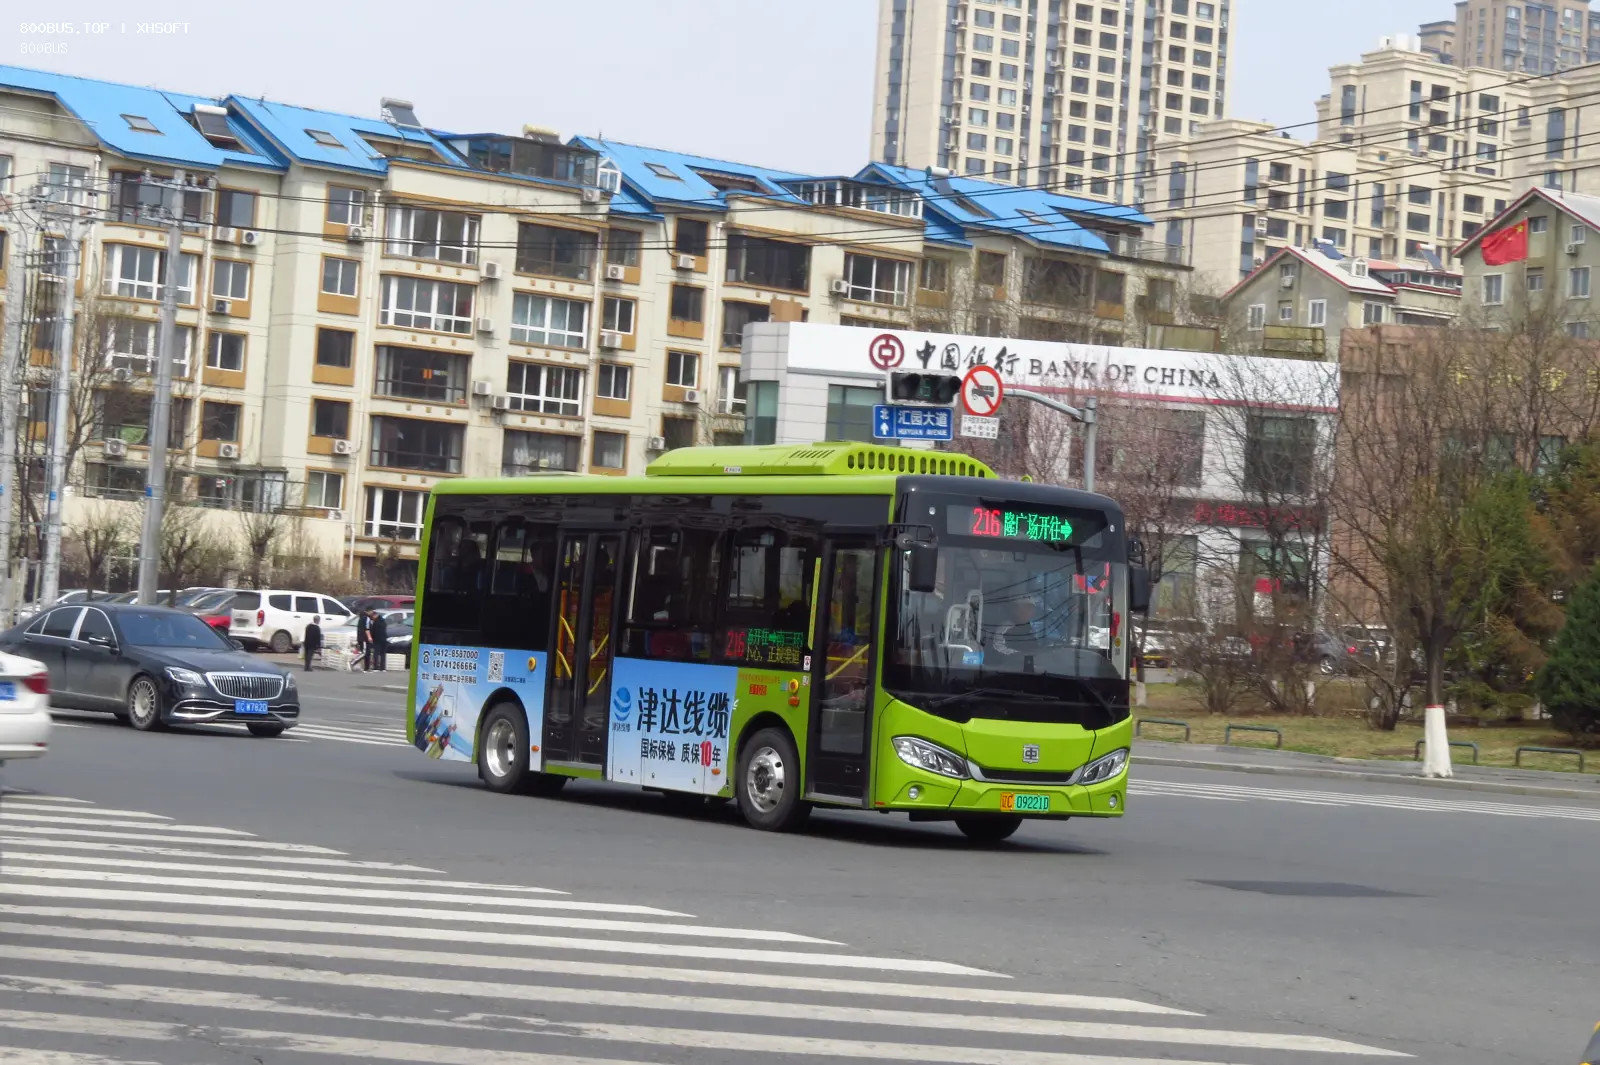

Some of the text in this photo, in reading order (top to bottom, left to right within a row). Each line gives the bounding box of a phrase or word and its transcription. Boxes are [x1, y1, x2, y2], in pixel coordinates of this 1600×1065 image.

[916, 340, 1020, 376] 中国银行
[1029, 358, 1222, 388] BANK OF CHINA
[898, 410, 948, 427] 汇园大道
[973, 507, 1001, 536] 216
[1003, 511, 1061, 541] 隆广场开往
[725, 631, 746, 657] 216
[637, 686, 730, 739] 津达线缆
[641, 738, 721, 767] 国标保检 质保10年
